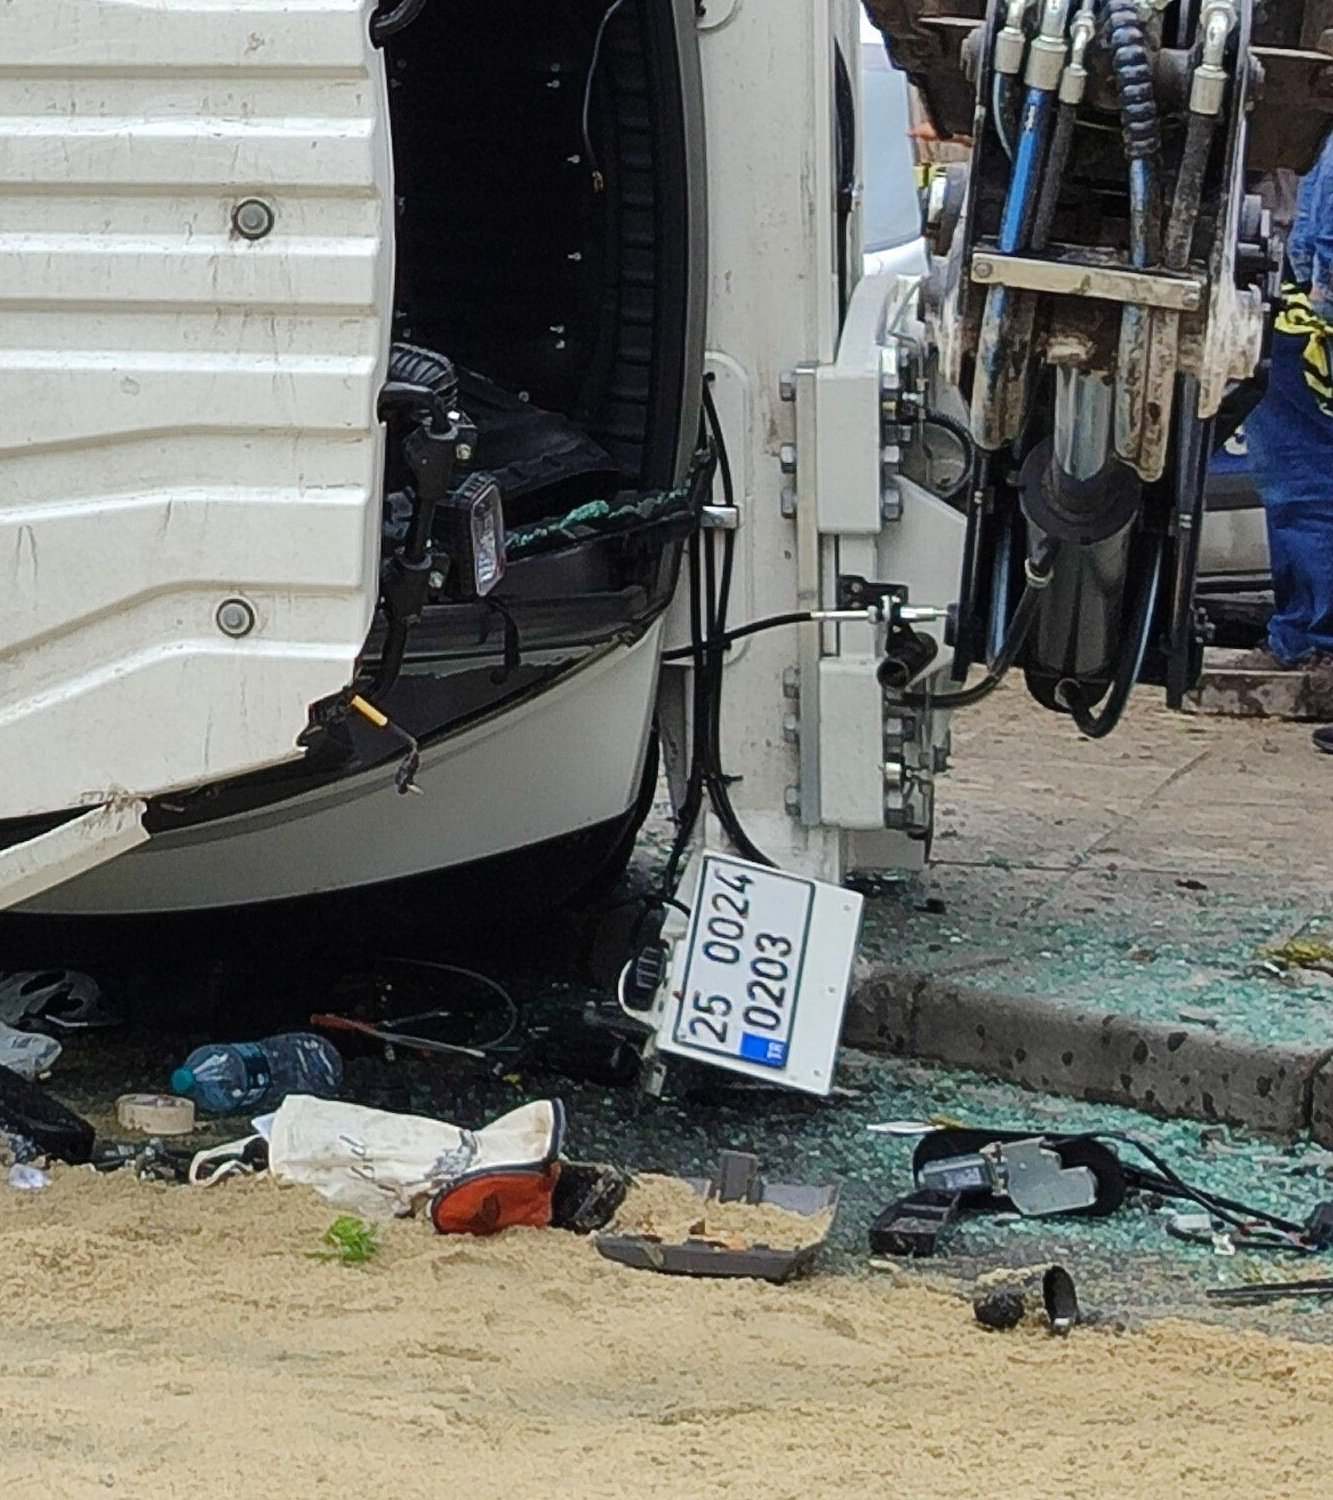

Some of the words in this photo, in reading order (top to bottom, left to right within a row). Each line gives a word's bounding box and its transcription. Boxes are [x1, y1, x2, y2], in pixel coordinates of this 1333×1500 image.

[702, 868, 756, 965] 0024
[688, 990, 733, 1043] 25
[742, 932, 793, 1032] 0203
[766, 1042, 784, 1061] TR
